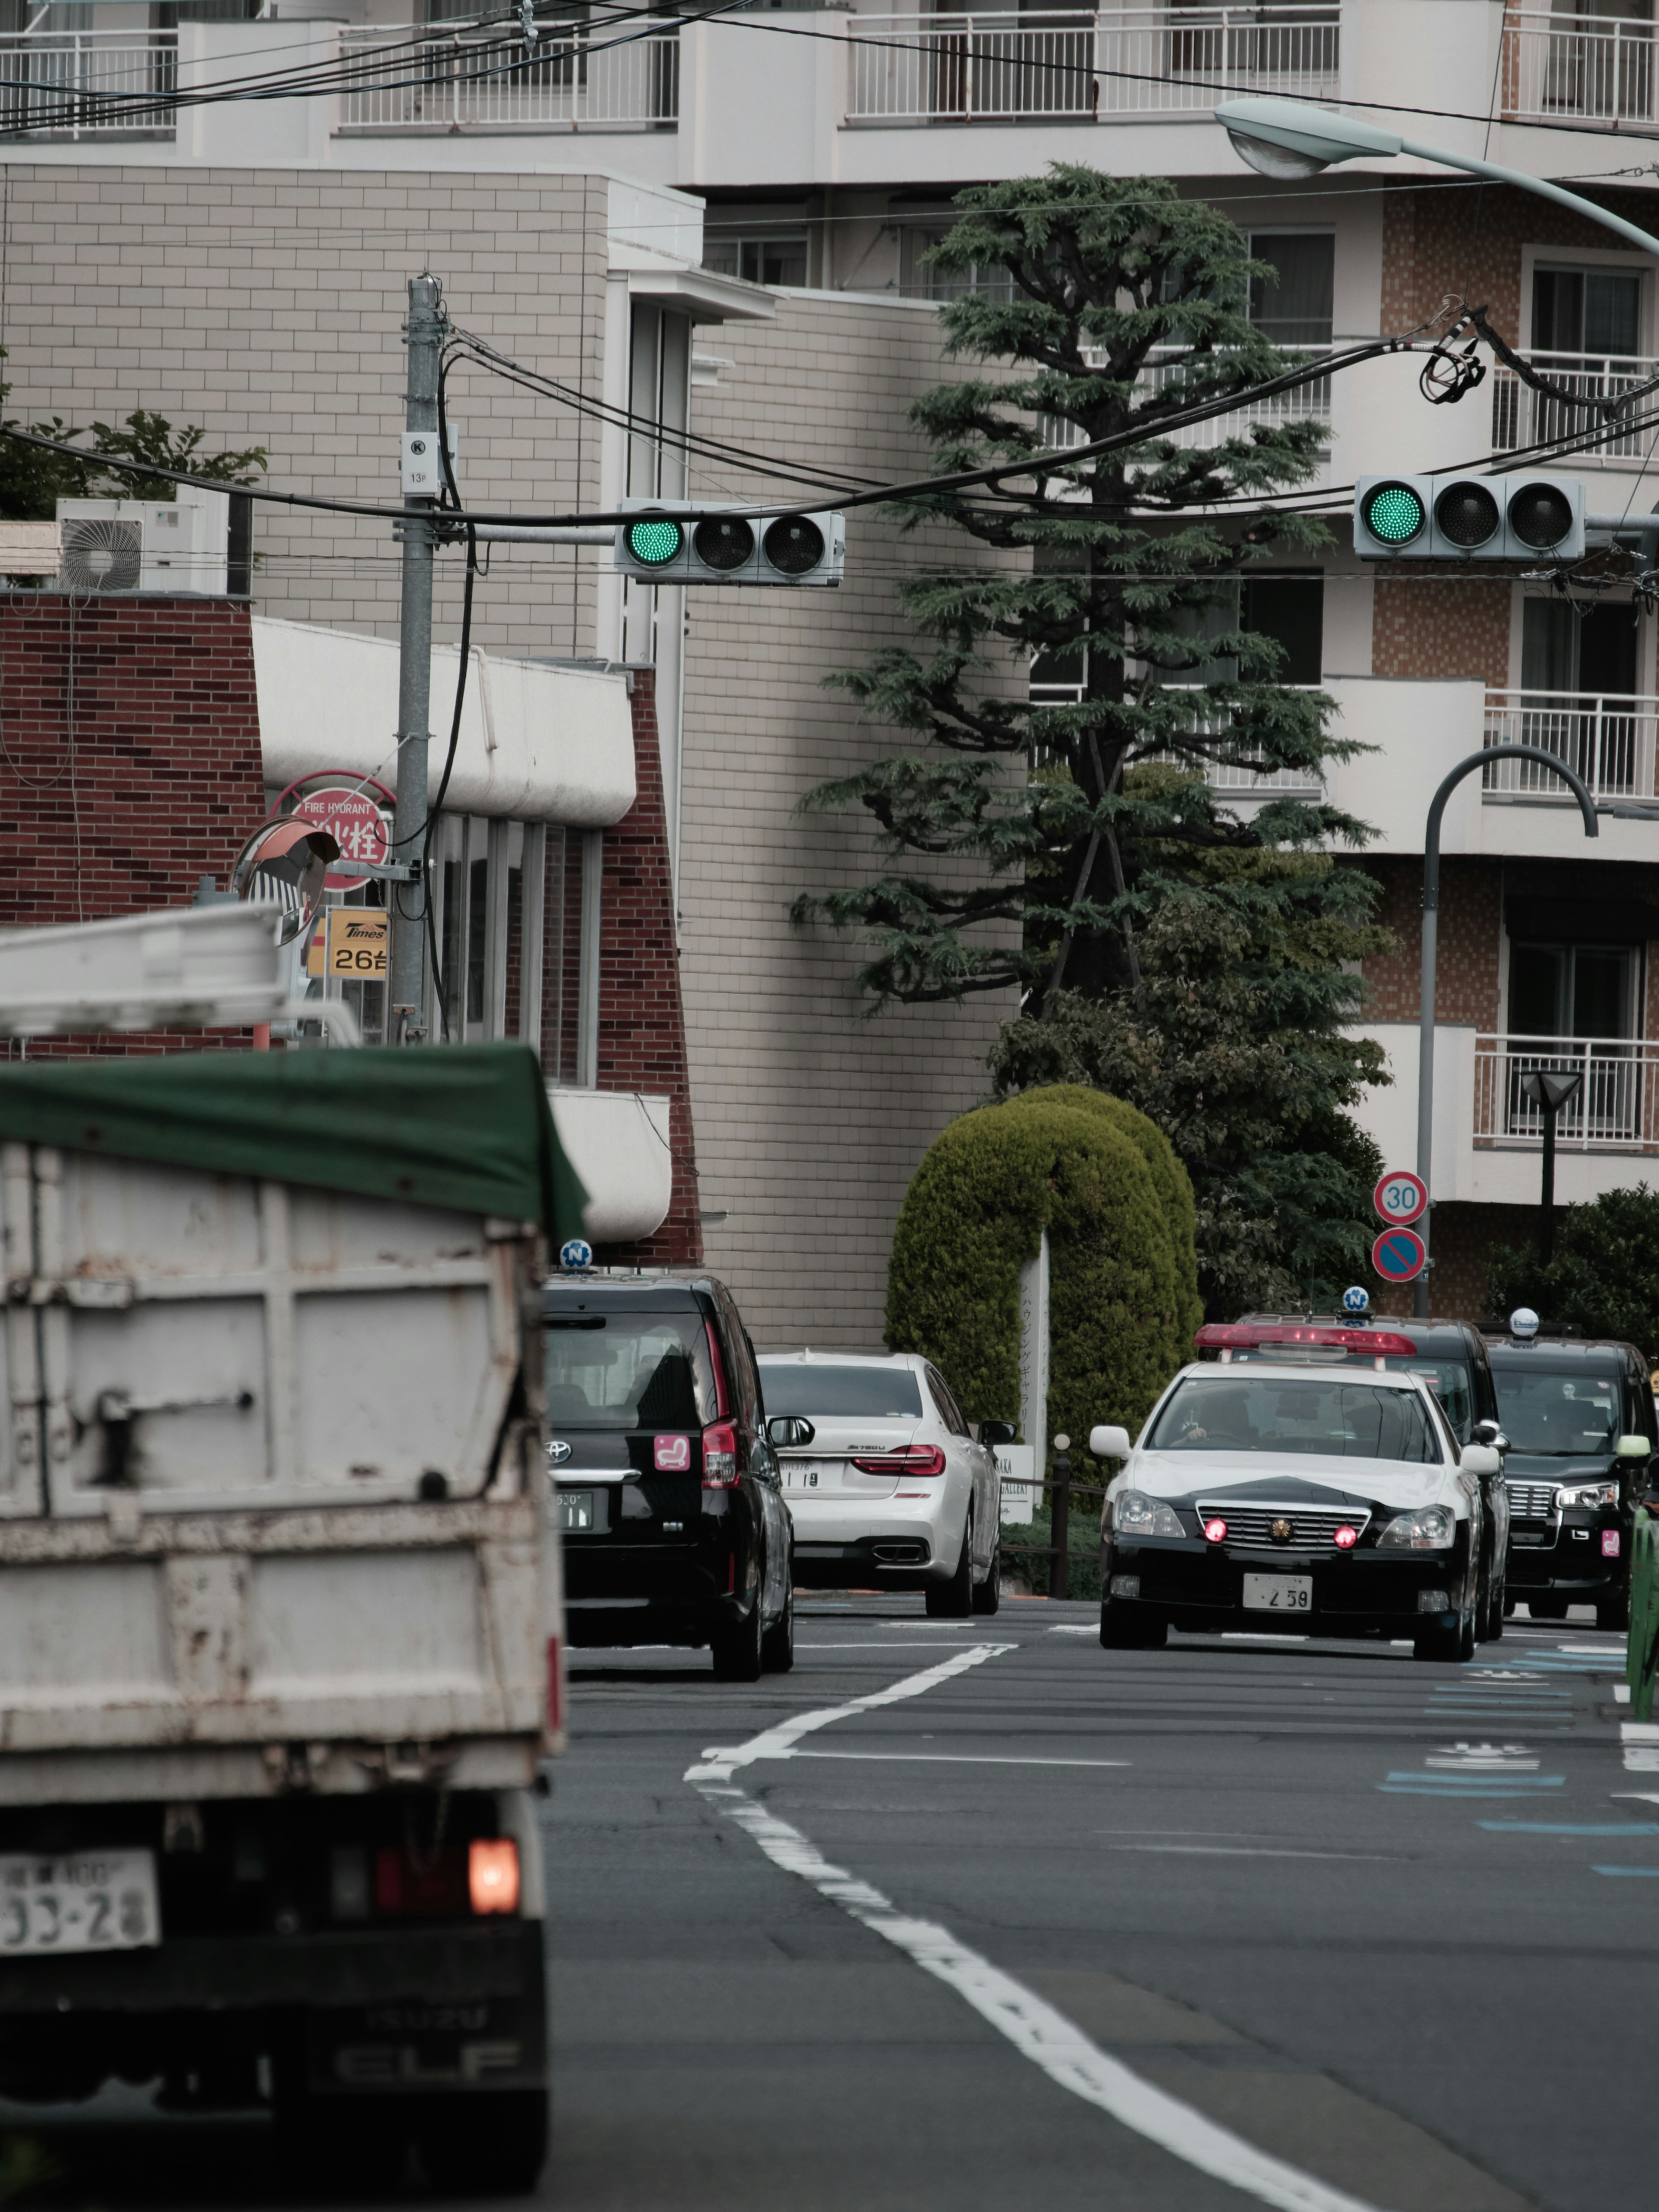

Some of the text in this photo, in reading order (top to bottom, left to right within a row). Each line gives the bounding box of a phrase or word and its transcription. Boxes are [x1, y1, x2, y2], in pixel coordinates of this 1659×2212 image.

[413, 443, 423, 452] K
[305, 802, 372, 815] FIRE HYDRANT
[313, 820, 380, 859] 火栓
[345, 923, 385, 939] Times
[1387, 1186, 1415, 1209] 30
[569, 1248, 582, 1262] N
[1350, 1295, 1361, 1306] N
